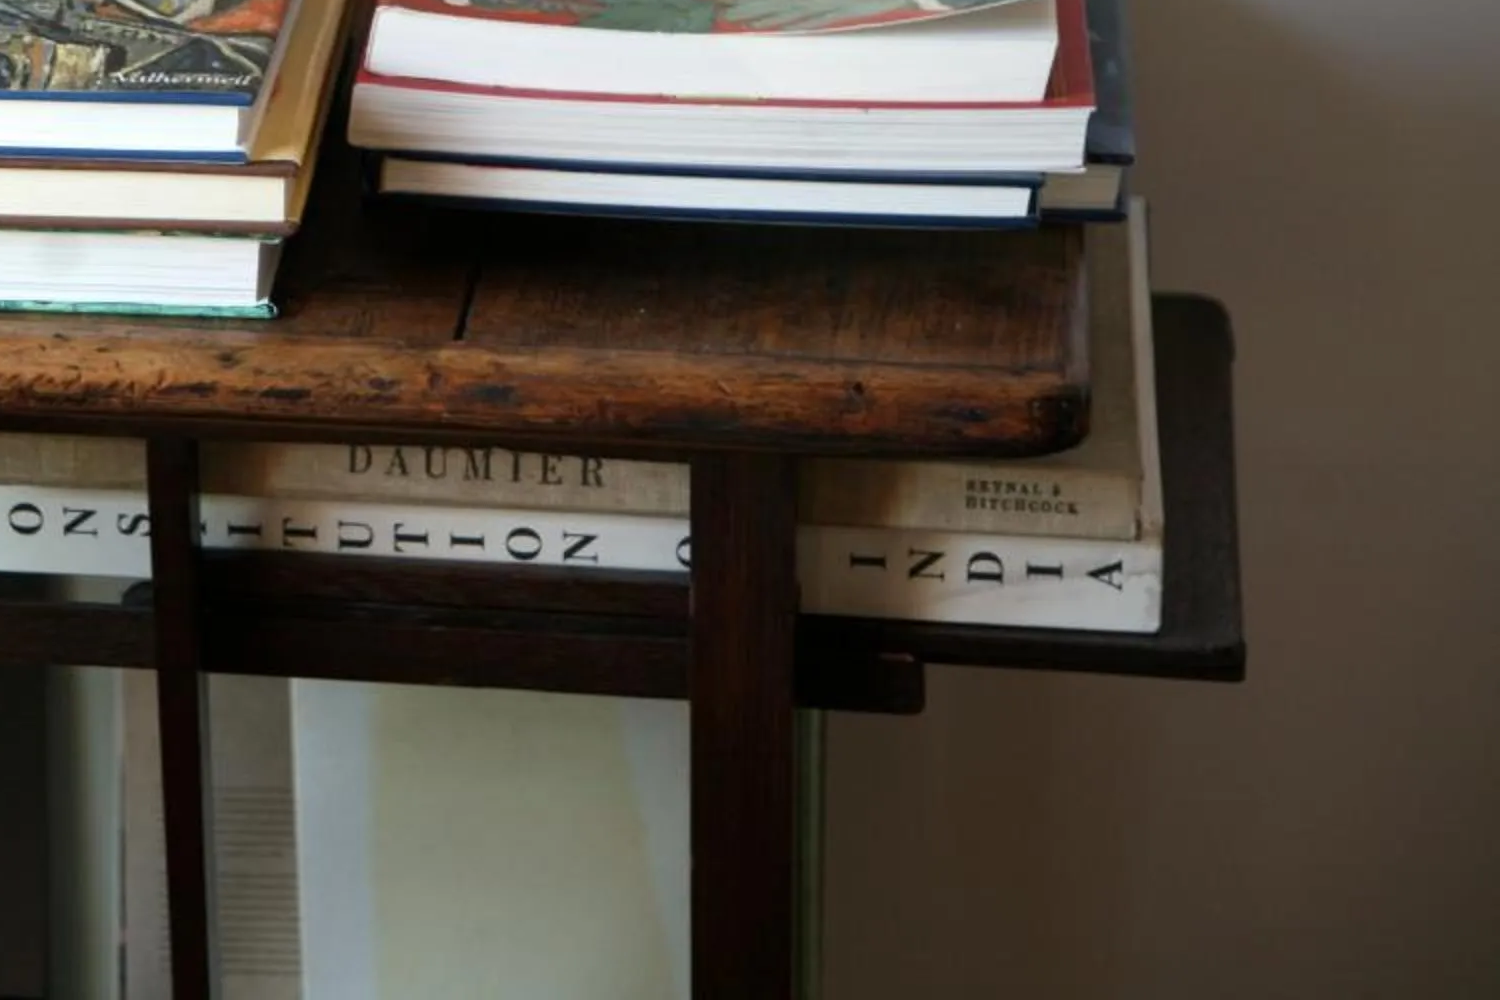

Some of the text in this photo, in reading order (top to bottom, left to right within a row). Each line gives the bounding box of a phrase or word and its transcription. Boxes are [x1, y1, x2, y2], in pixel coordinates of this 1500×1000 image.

[348, 444, 606, 489] DAUMIER
[964, 495, 1080, 516] HITCHCOCK
[850, 547, 1124, 592] INDIA
